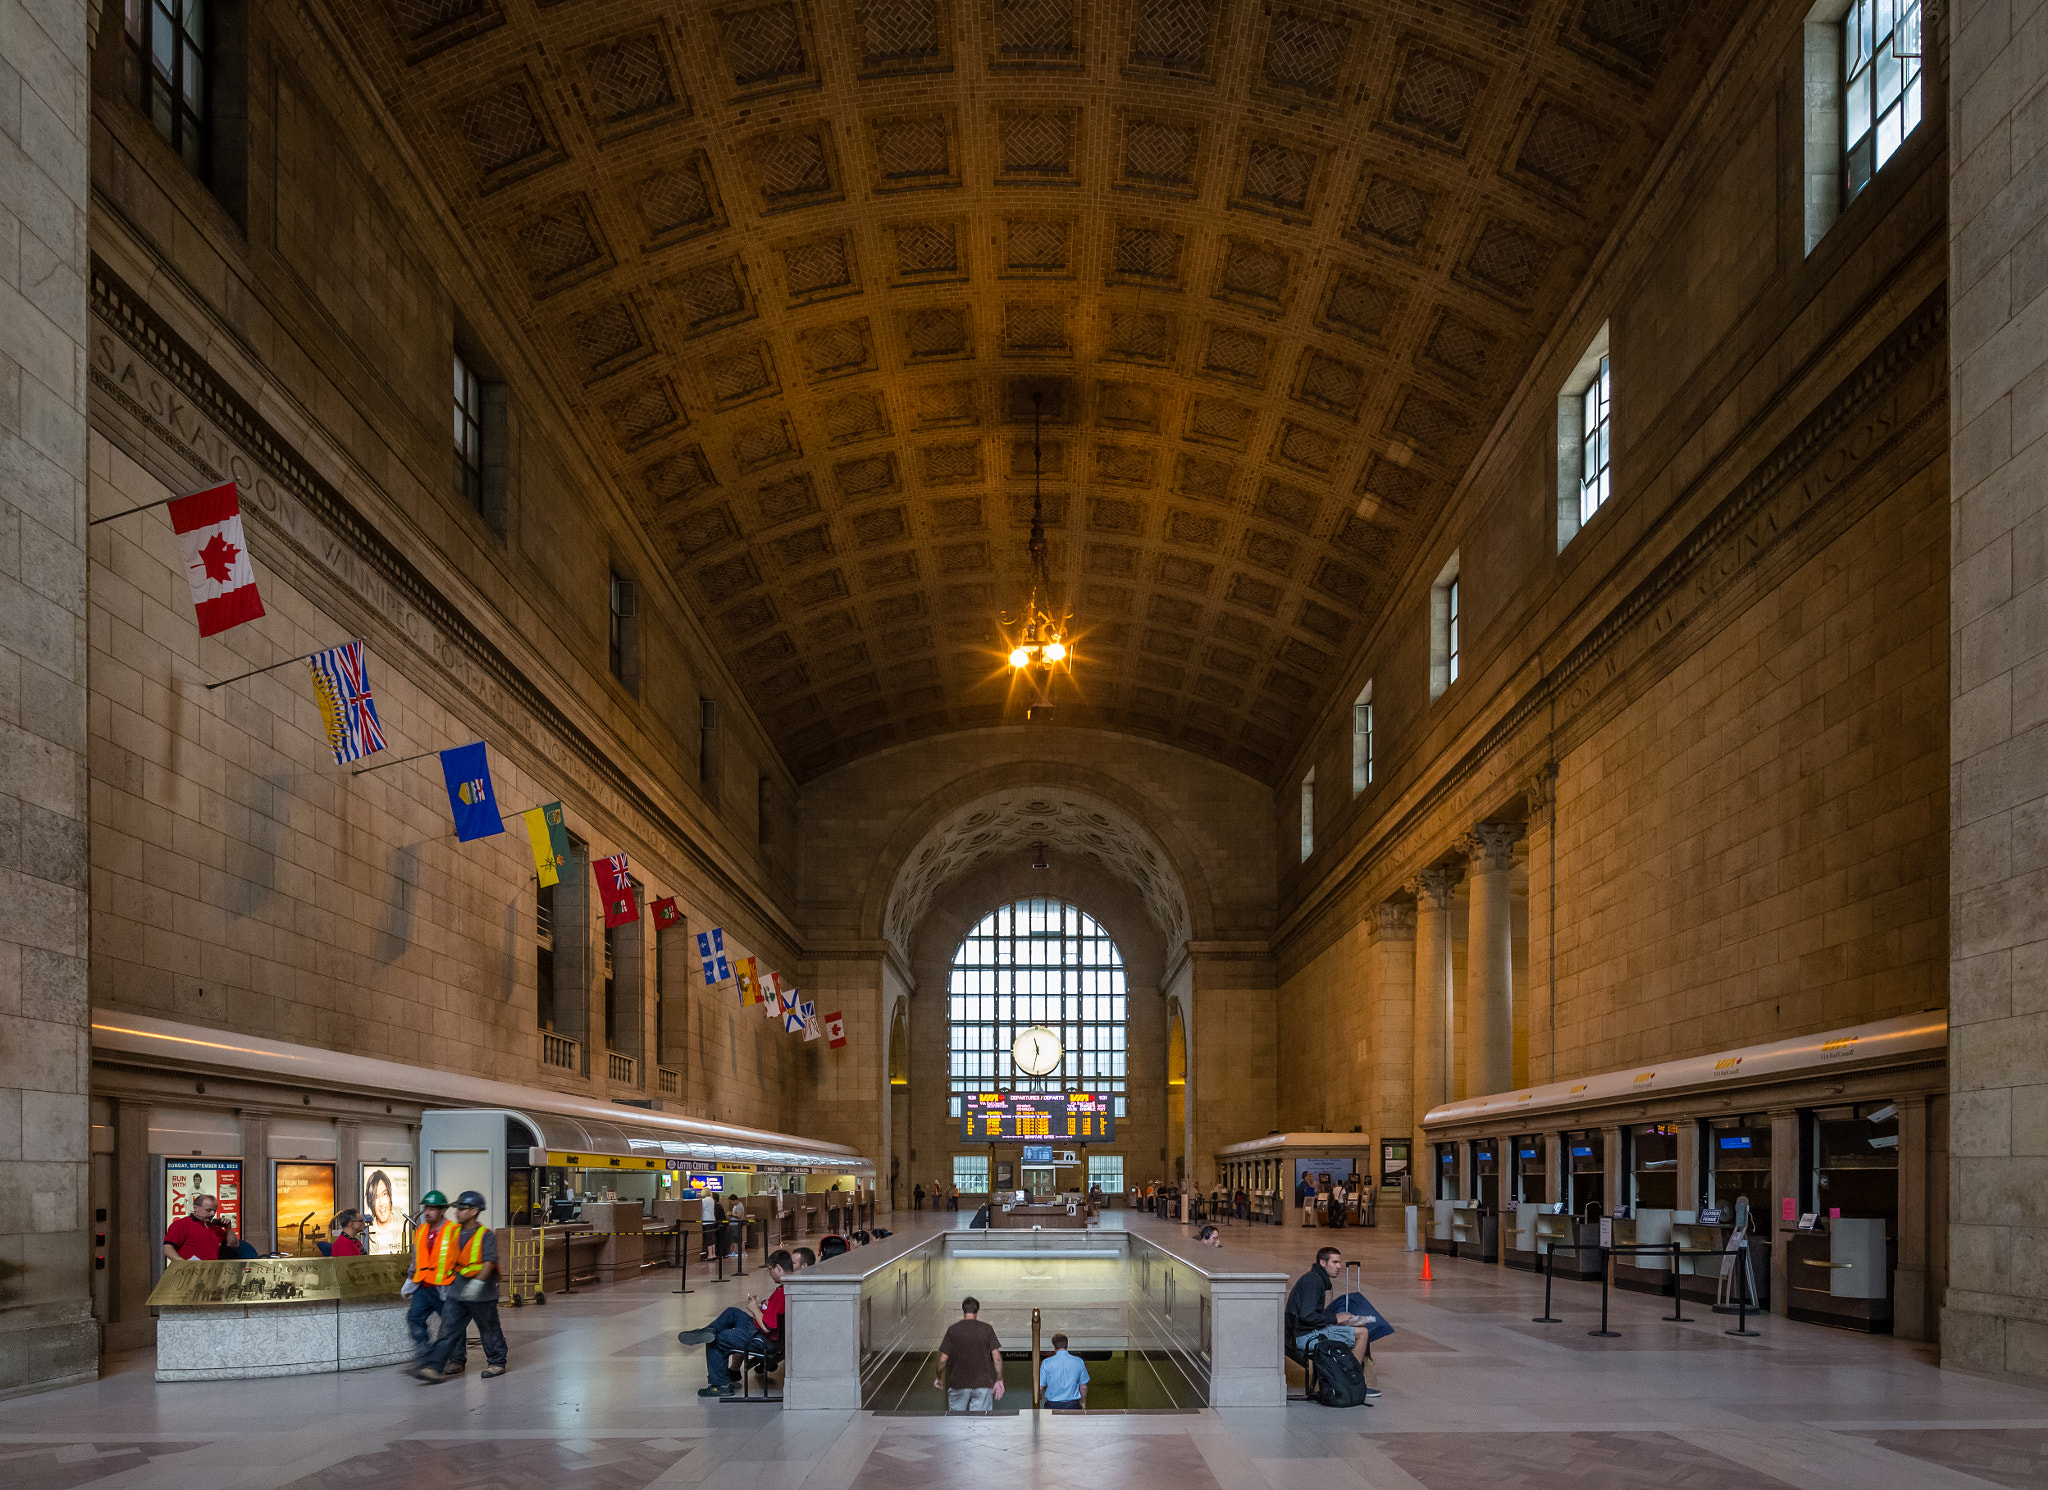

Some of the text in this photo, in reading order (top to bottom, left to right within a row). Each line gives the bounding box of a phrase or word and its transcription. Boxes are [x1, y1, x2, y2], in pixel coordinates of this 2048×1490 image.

[97, 333, 297, 530] SASKATOON
[318, 526, 420, 639] WINNIPEG
[979, 1094, 999, 1102] VIA
[1070, 1094, 1089, 1102] VIA
[566, 1155, 579, 1164] Hertz
[609, 1158, 620, 1166] Hertz
[646, 1160, 655, 1168] Hertz
[676, 1160, 692, 1170] LOTTO
[692, 1161, 710, 1171] CENTRE
[607, 1192, 617, 1200] OPEN
[175, 1264, 320, 1276] PORTEURS RED CAPS
